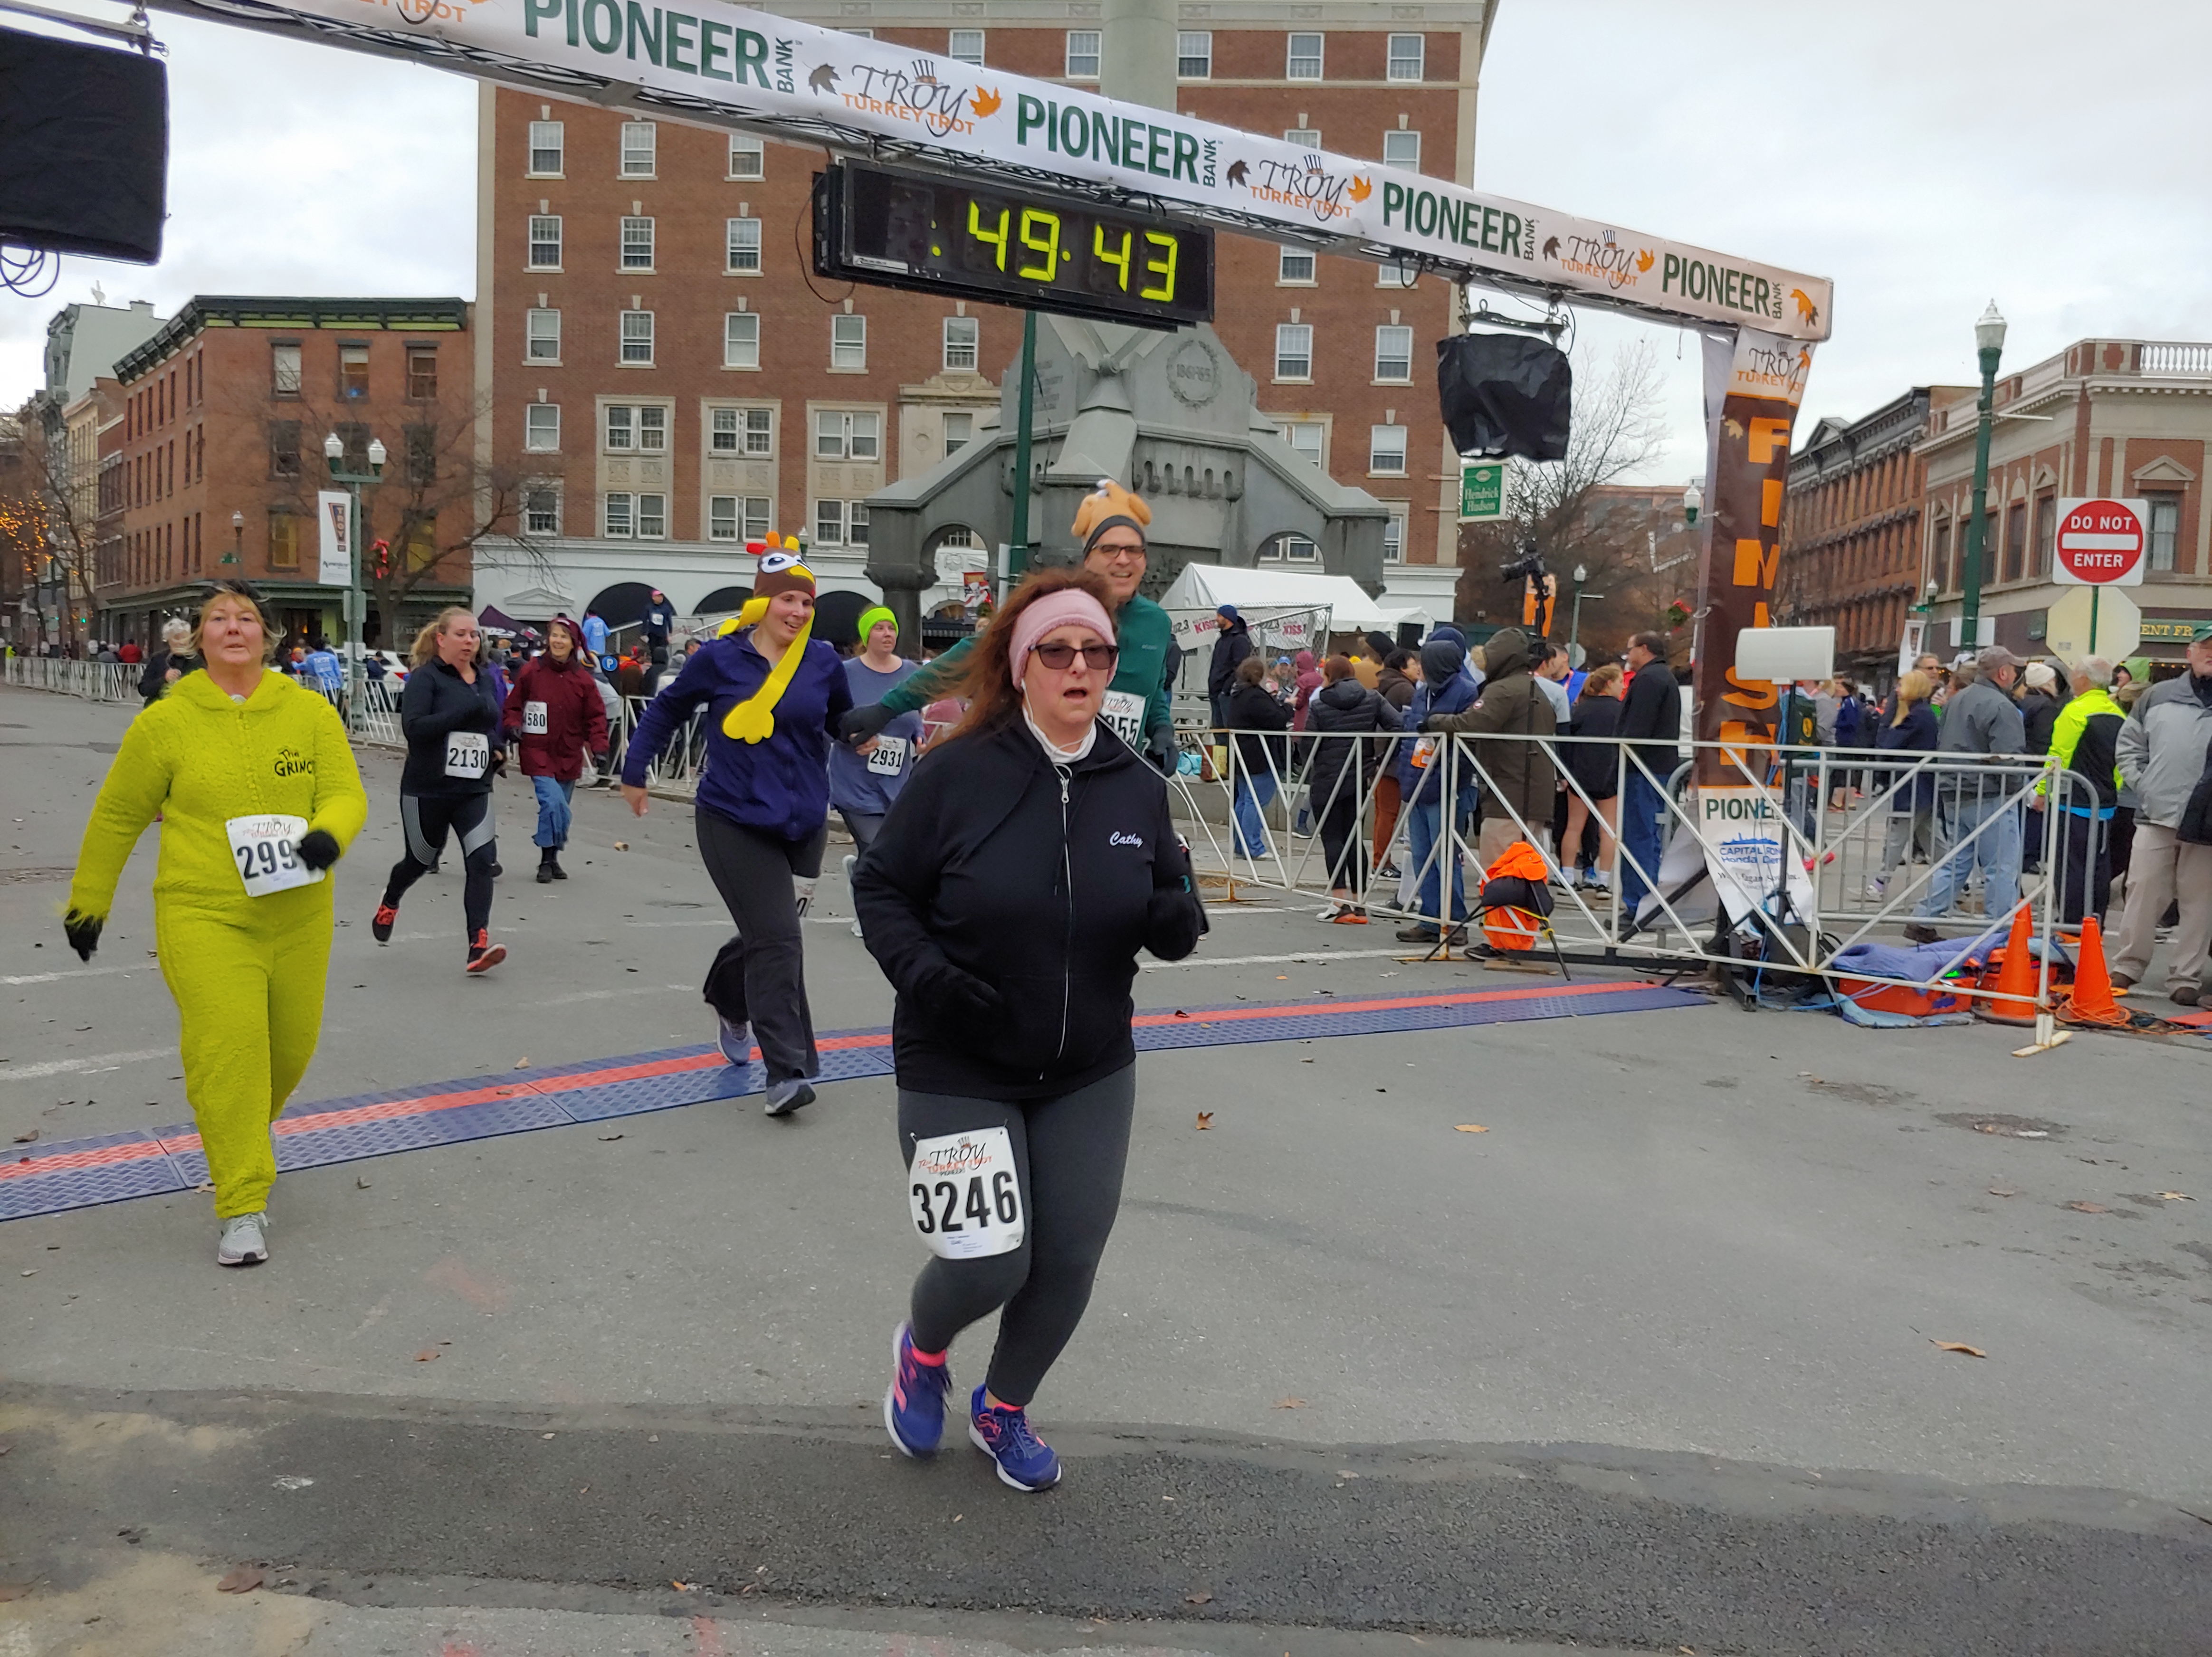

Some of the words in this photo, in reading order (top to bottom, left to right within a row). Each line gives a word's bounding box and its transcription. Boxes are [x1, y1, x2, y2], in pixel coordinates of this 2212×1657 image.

[403, 0, 467, 22] TROT
[525, 0, 772, 90] PIONEER
[775, 37, 794, 95] BANK
[841, 93, 922, 123] TURKEY
[927, 112, 975, 135] TROT
[1017, 93, 1200, 185] PIONEER
[1203, 138, 1216, 188] BANK
[1250, 186, 1313, 210] TURKEY
[1316, 200, 1353, 218] TROT
[1383, 181, 1521, 258] PIONEER
[1524, 218, 1535, 261] BANK
[1561, 258, 1608, 279] TURKEY
[1610, 270, 1638, 286] TROT
[1662, 253, 1770, 317] PIONEER
[1772, 282, 1783, 319] BANK
[1737, 371, 1785, 386] TURKEY
[2070, 515, 2092, 529] DO
[2100, 516, 2133, 530] NOT
[2074, 553, 2123, 568] ENTER
[606, 658, 614, 668] P
[279, 749, 300, 760] The
[448, 748, 487, 769] 2130
[870, 748, 902, 768] 2931
[275, 760, 315, 777] GRINC
[1109, 831, 1143, 848] Cathy
[1719, 847, 1763, 856] CAPITAL
[1721, 856, 1758, 864] Honda
[927, 1161, 966, 1173] TURKEY
[930, 1142, 986, 1170] TROY
[913, 1171, 1018, 1234] 3246
